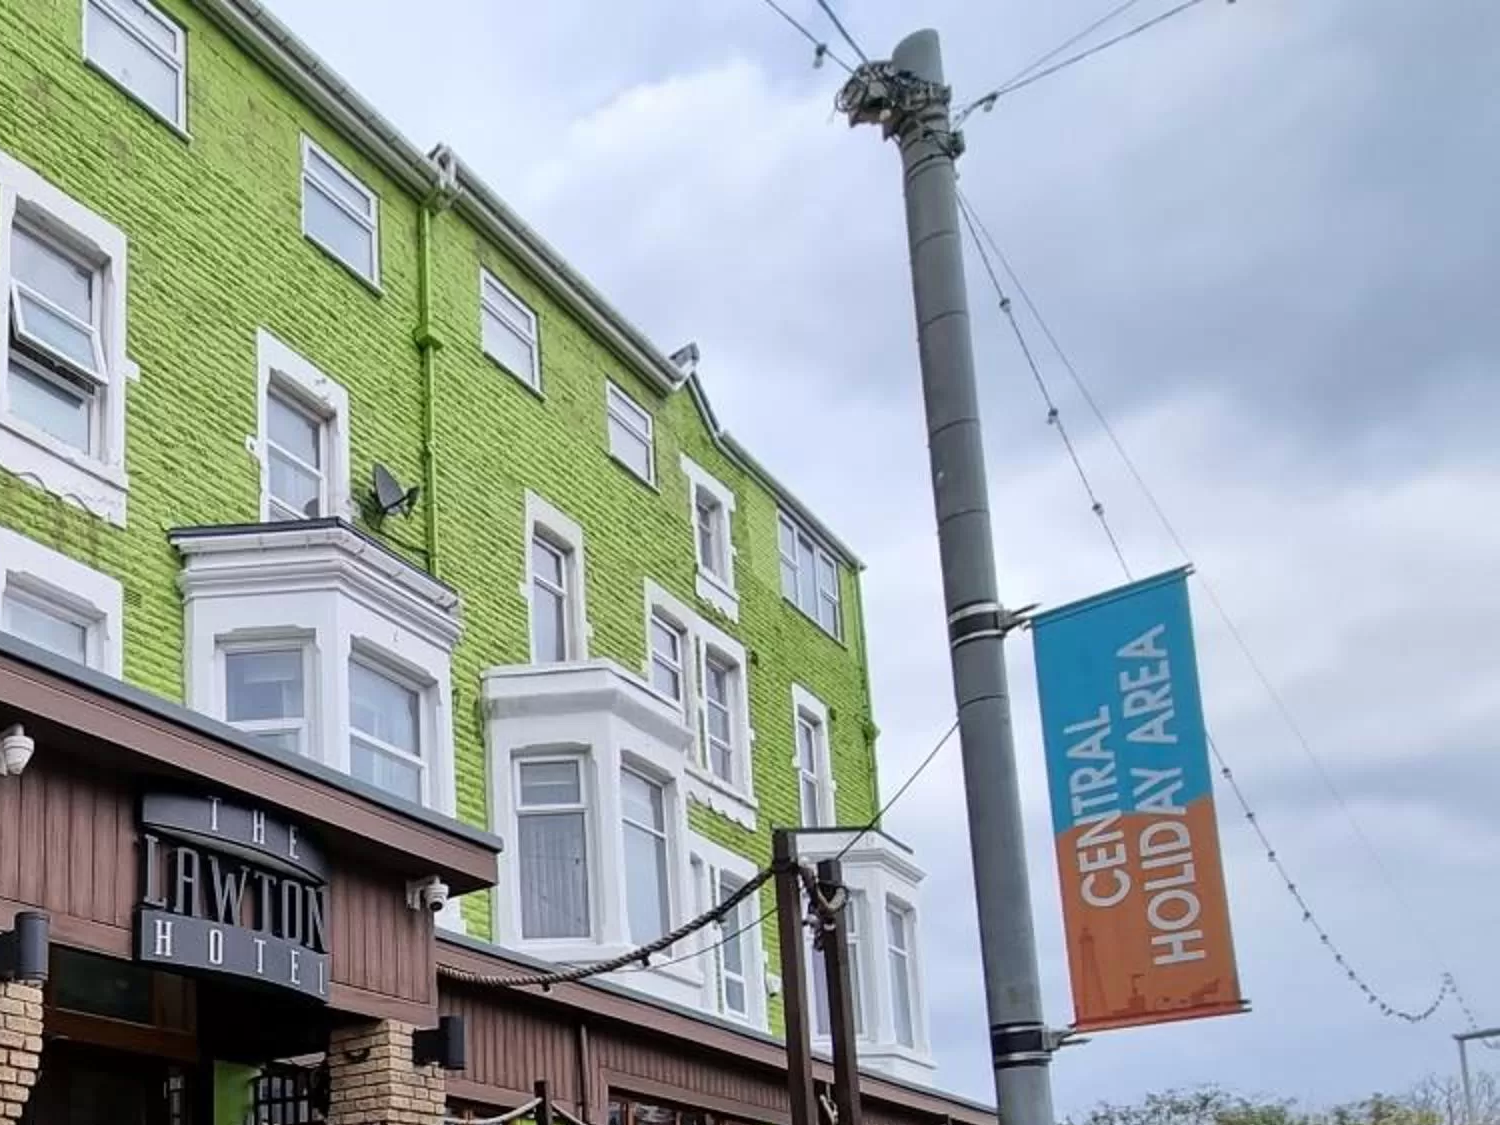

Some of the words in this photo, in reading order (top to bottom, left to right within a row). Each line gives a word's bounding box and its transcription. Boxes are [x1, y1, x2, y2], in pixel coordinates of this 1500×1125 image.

[1116, 623, 1179, 743] AREA
[208, 797, 301, 860] THE
[1064, 703, 1131, 908] CENTRAL
[144, 833, 332, 954] LAWTON
[1131, 767, 1206, 965] HOLIDAY
[153, 919, 326, 996] HOTEL
